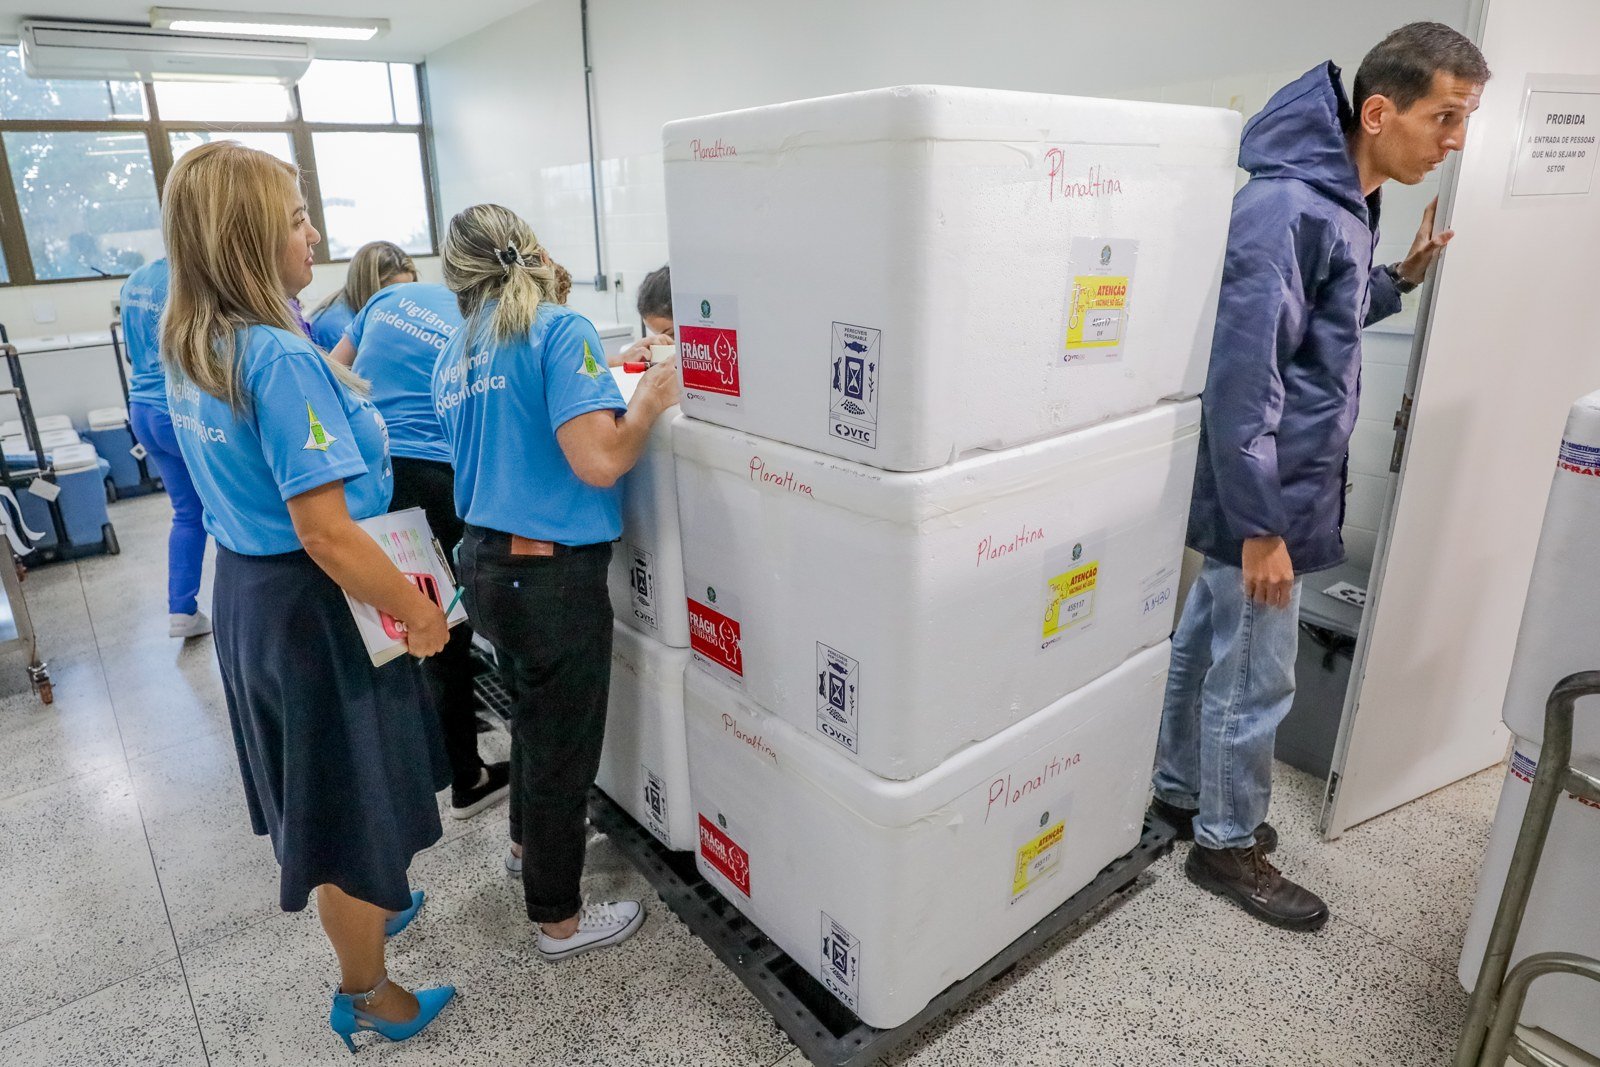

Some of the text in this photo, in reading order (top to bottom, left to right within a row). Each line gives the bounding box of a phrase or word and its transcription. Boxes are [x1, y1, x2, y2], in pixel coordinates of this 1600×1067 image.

[1546, 114, 1585, 125] PROIBIDA
[690, 138, 738, 162] Planaltina
[1534, 136, 1560, 144] ENTRADA
[1570, 136, 1595, 144] PESSOAS
[1532, 151, 1543, 159] QUE
[1545, 150, 1556, 158] NÃO
[1044, 148, 1122, 202] Planaltina
[1546, 165, 1565, 173] SETOR
[373, 308, 448, 350] Epidemioló
[398, 297, 457, 336] Vigilânci
[681, 339, 712, 361] FRÁGIL
[682, 360, 713, 372] CUIDADO
[749, 455, 815, 500] Planaltina
[976, 524, 1045, 568] Planaltina
[689, 611, 717, 638] FRÁGIL
[690, 624, 718, 646] CUIDADO
[721, 713, 778, 765] Planaltina
[984, 753, 1081, 825] Planaltina
[700, 825, 728, 859] FRÁGIL
